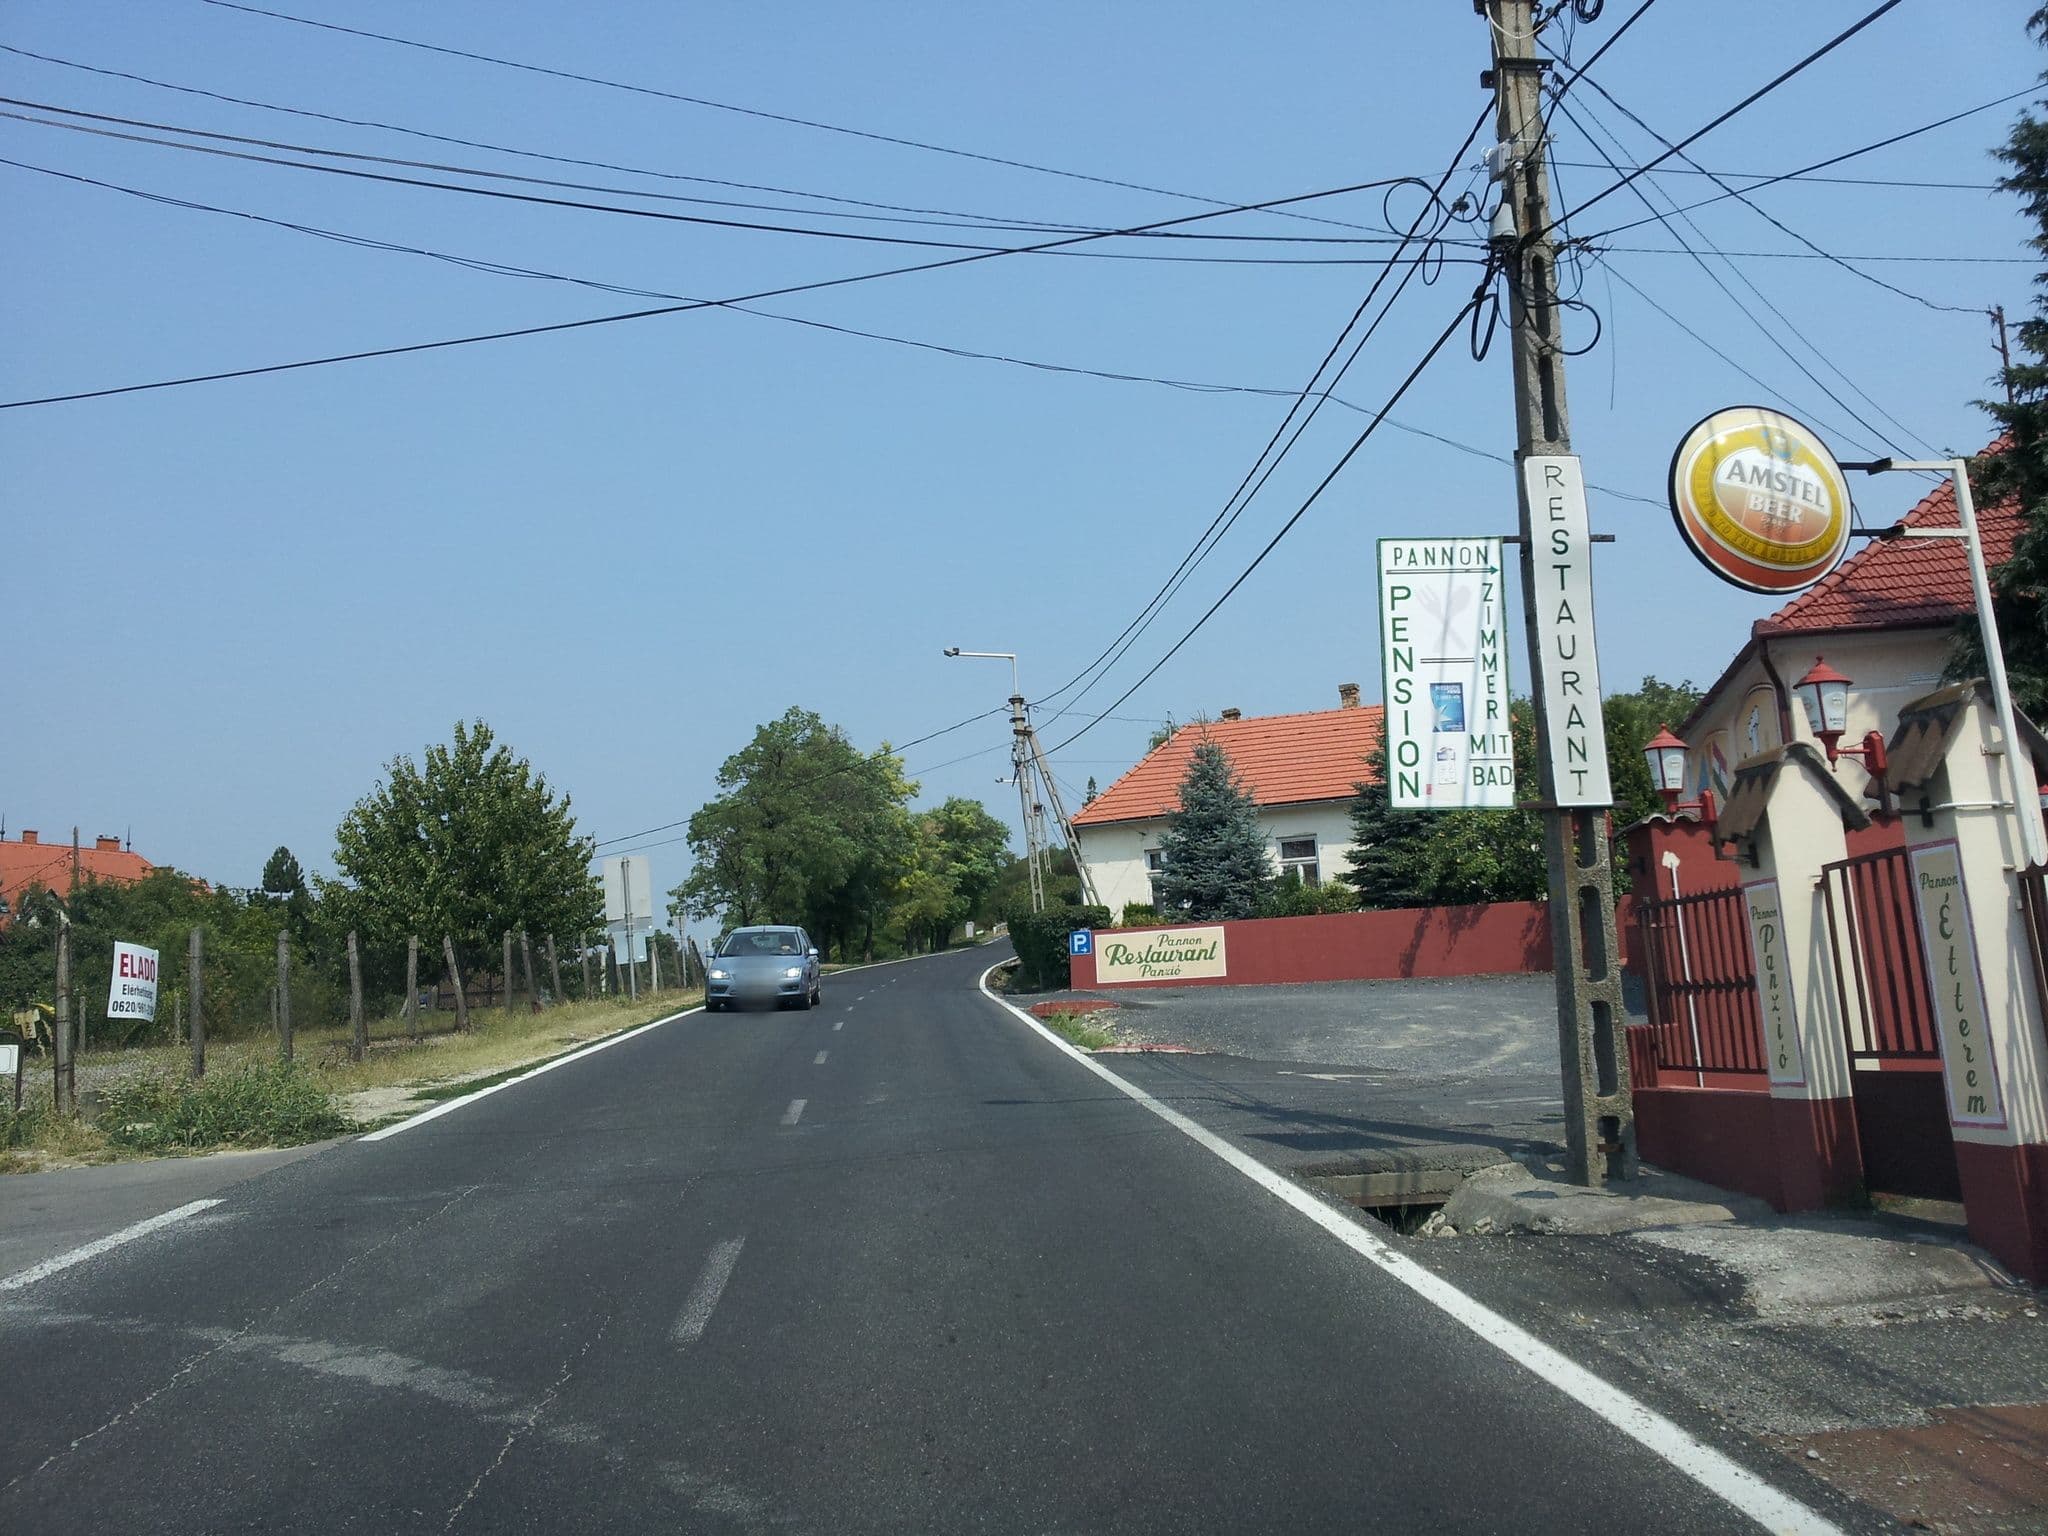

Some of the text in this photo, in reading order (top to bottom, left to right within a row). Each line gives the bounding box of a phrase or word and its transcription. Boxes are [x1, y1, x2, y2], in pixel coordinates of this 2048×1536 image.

[1726, 459, 1825, 508] AMSTEL
[1749, 493, 1803, 524] BEER
[1393, 546, 1489, 566] PANNON
[1544, 464, 1588, 796] RESTAURANT
[1480, 582, 1499, 720] ZIMMER
[1390, 585, 1420, 799] PENSION
[1470, 734, 1509, 755] MIT
[1472, 766, 1513, 786] BAD
[1919, 872, 1959, 891] Pannon
[1073, 934, 1087, 952] P
[1105, 940, 1218, 967] Restaurant
[1157, 934, 1202, 948] Pannon
[119, 953, 156, 983] ELADÓ
[1139, 963, 1182, 978] Panzió
[1758, 923, 1789, 1069] Panzió
[1939, 892, 1987, 1114] Étterem
